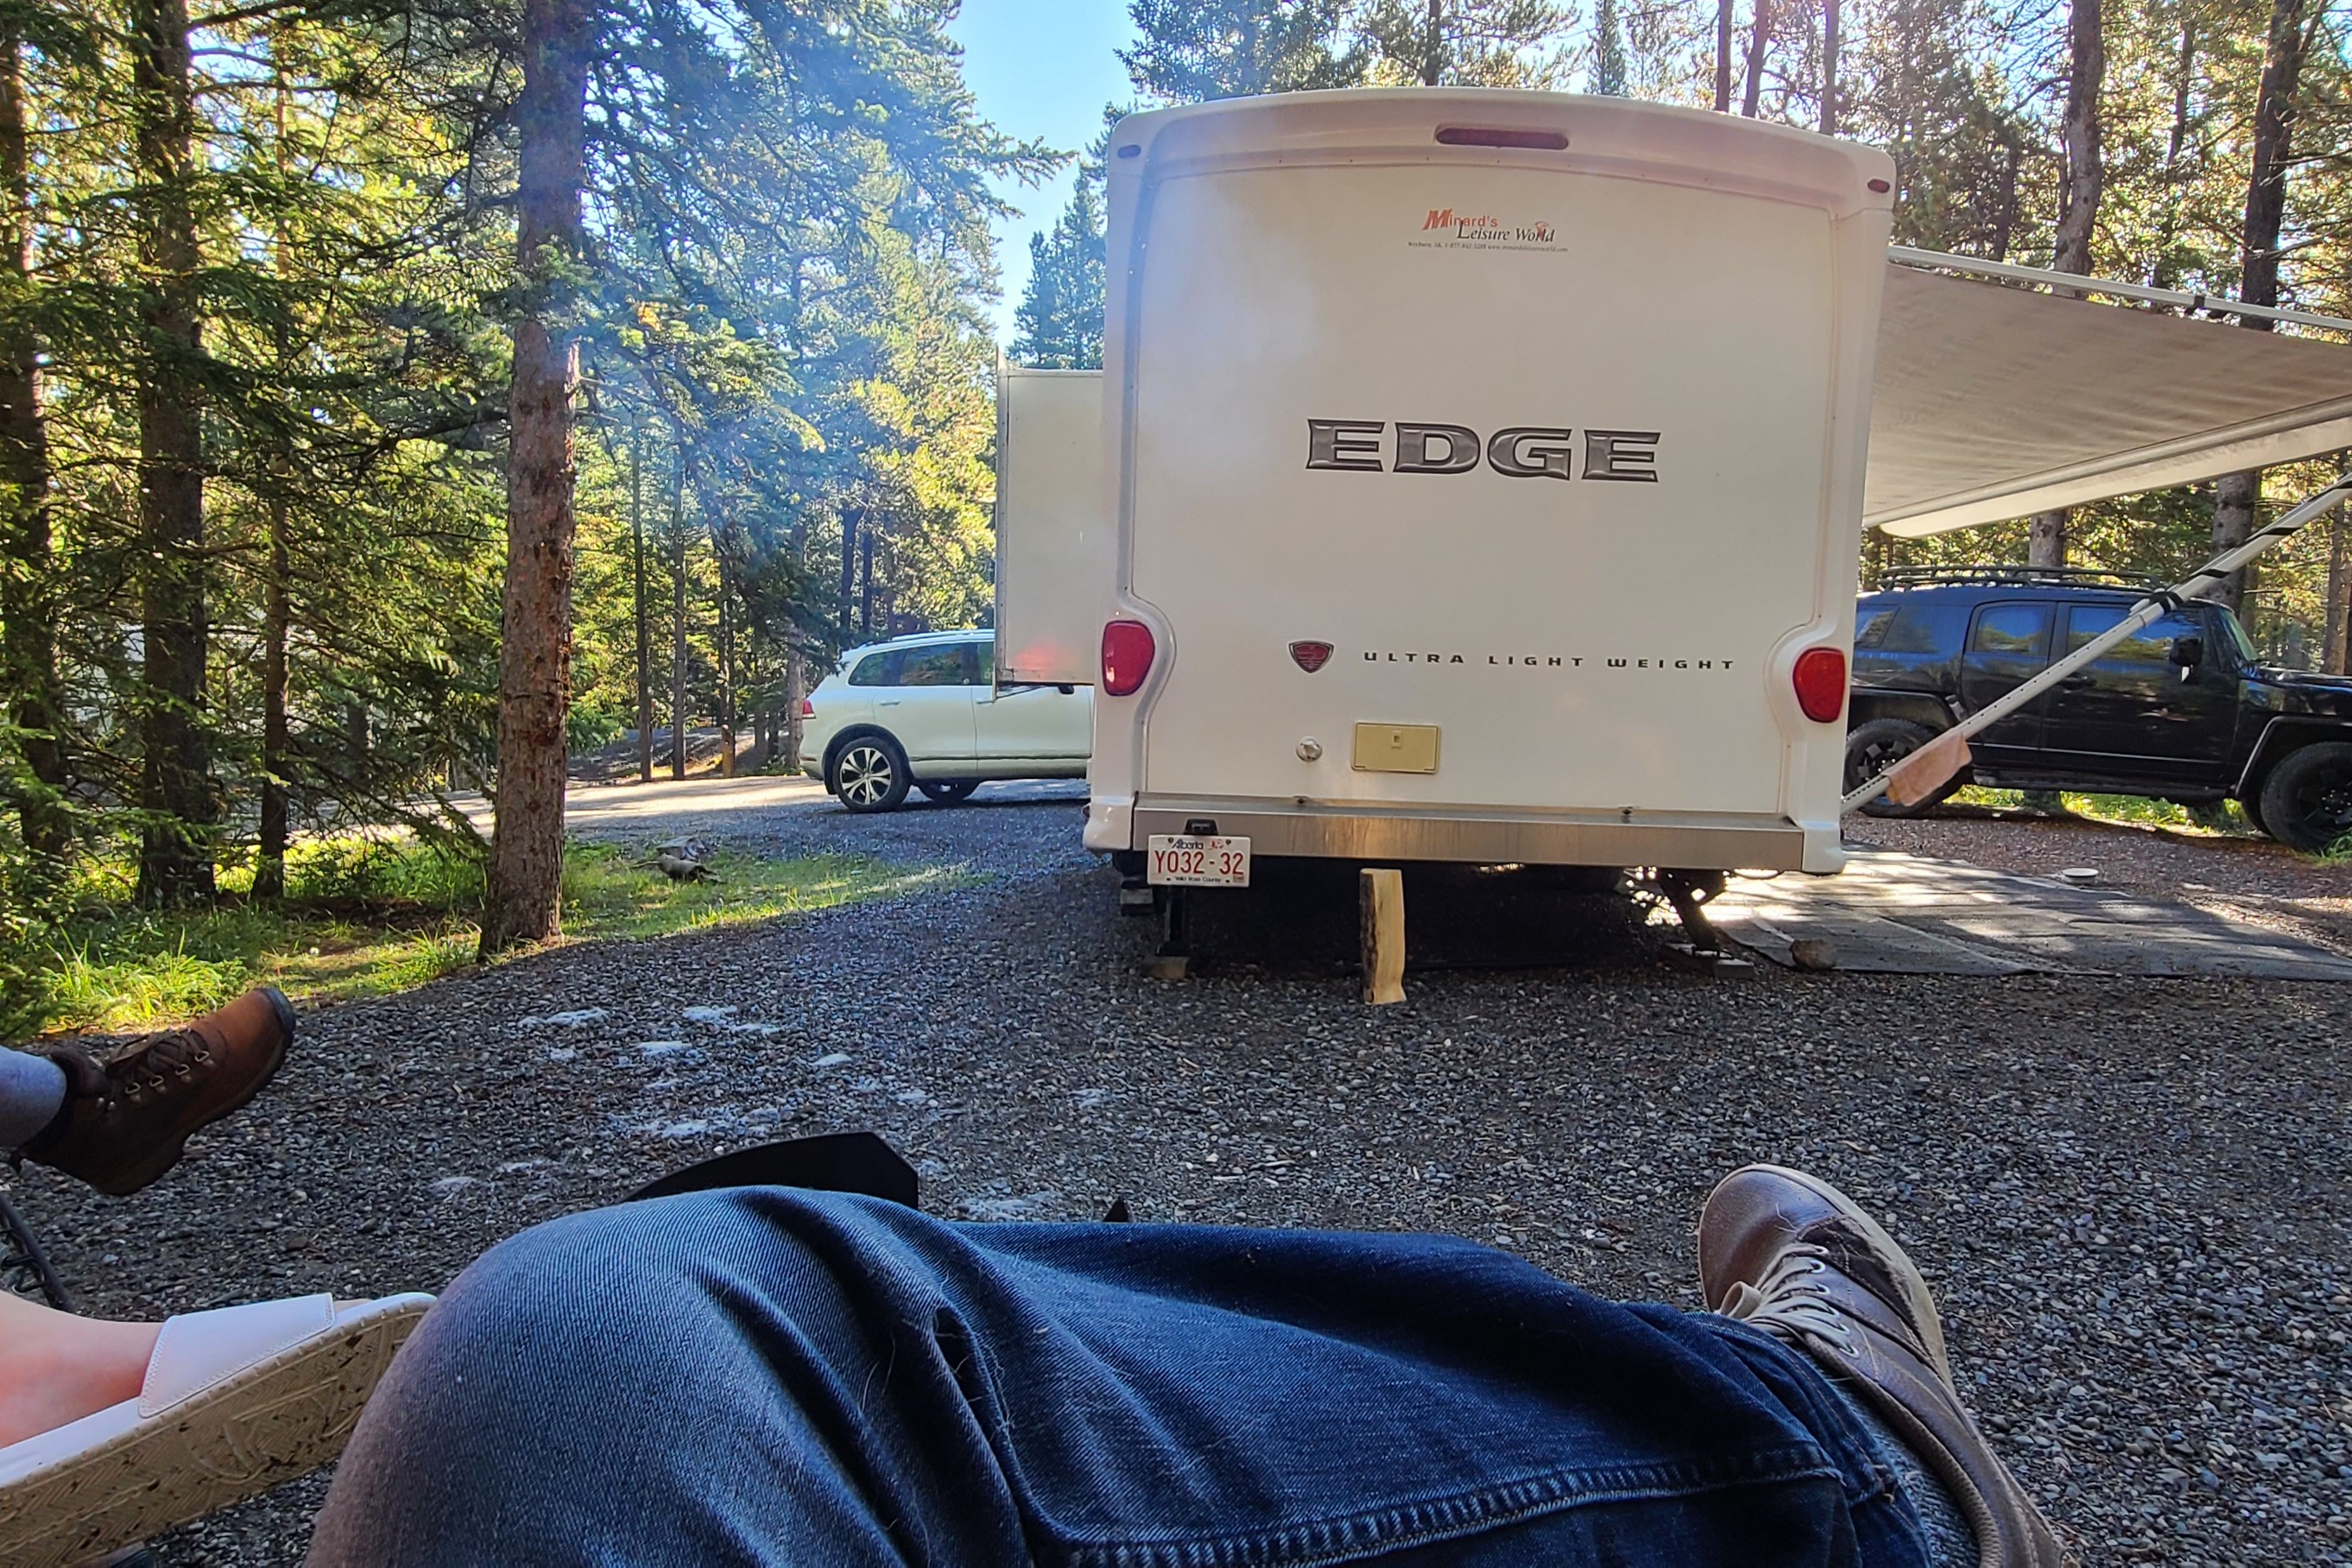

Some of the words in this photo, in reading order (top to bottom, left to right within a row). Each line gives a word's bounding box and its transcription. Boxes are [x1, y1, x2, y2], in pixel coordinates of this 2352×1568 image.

[1422, 207, 1498, 231] Minard's
[1457, 220, 1510, 241] Leisure
[1515, 228, 1555, 243] World
[1306, 419, 1661, 483] EDGE
[1364, 651, 1464, 664] ULTRA
[1489, 654, 1584, 667] LIGHT
[1607, 658, 1734, 670] WEIGHT
[1172, 839, 1204, 850] Alberta
